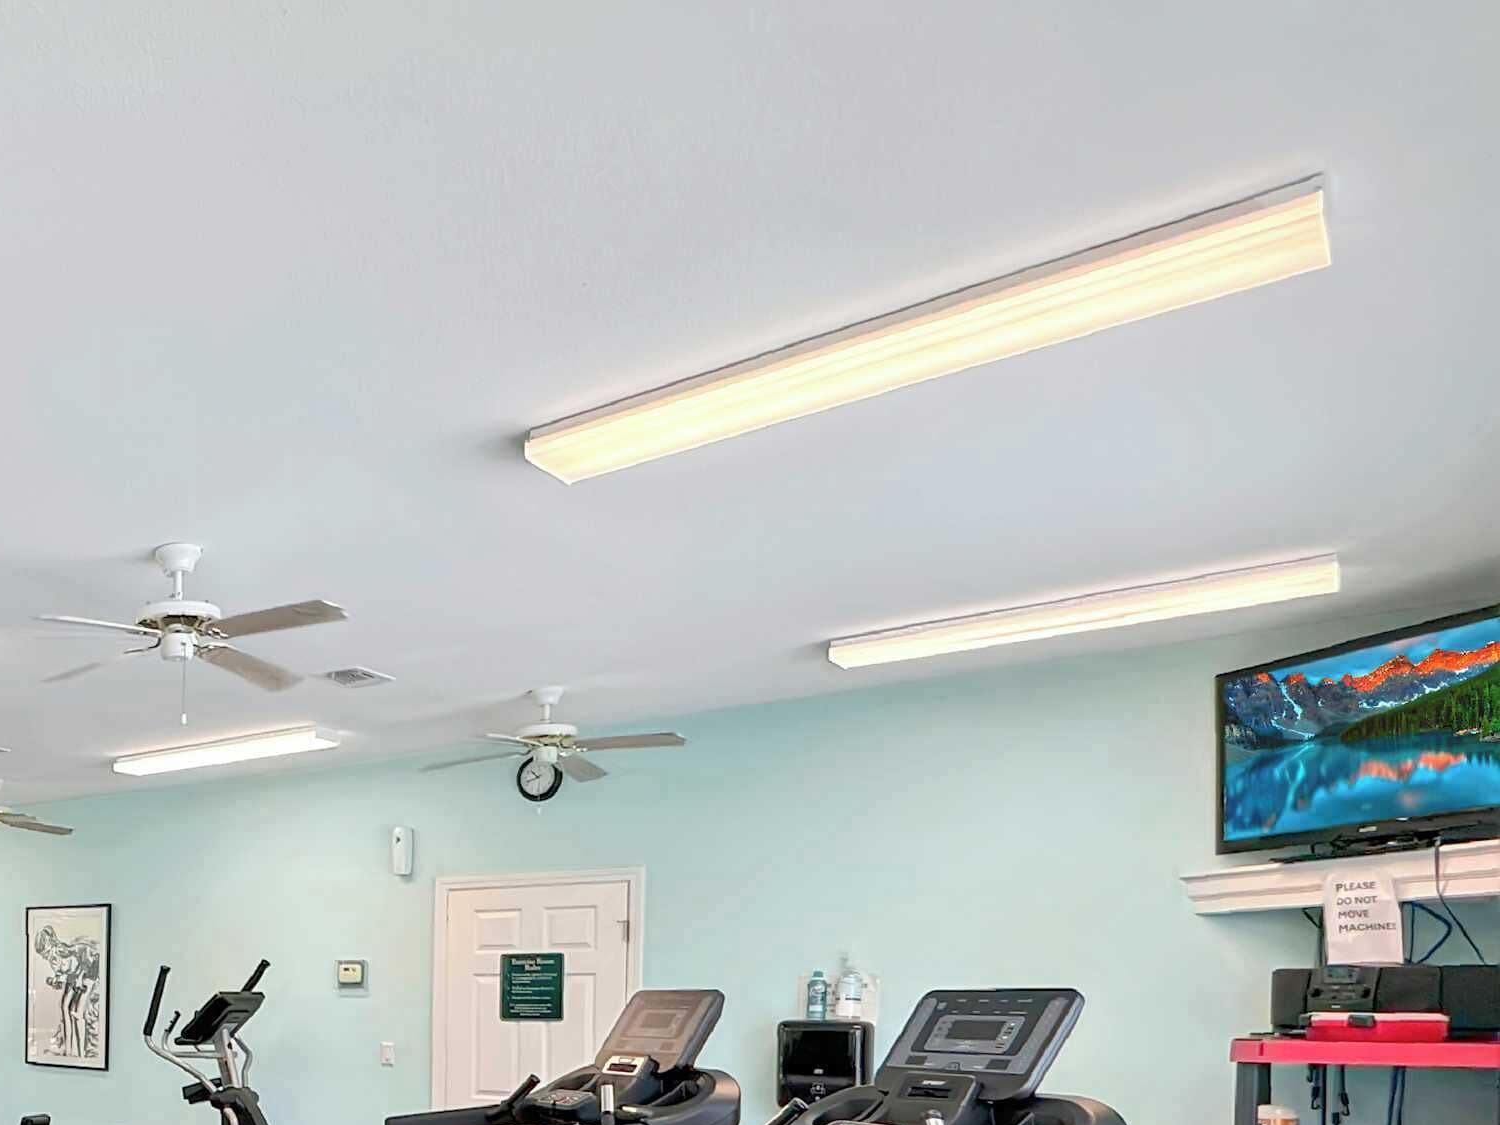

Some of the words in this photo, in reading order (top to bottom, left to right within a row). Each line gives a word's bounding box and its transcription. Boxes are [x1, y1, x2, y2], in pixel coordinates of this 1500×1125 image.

[1335, 882, 1376, 892] PLEASE
[1337, 897, 1352, 905] DO
[1354, 896, 1378, 904] NOT
[1338, 910, 1369, 919] MOVE
